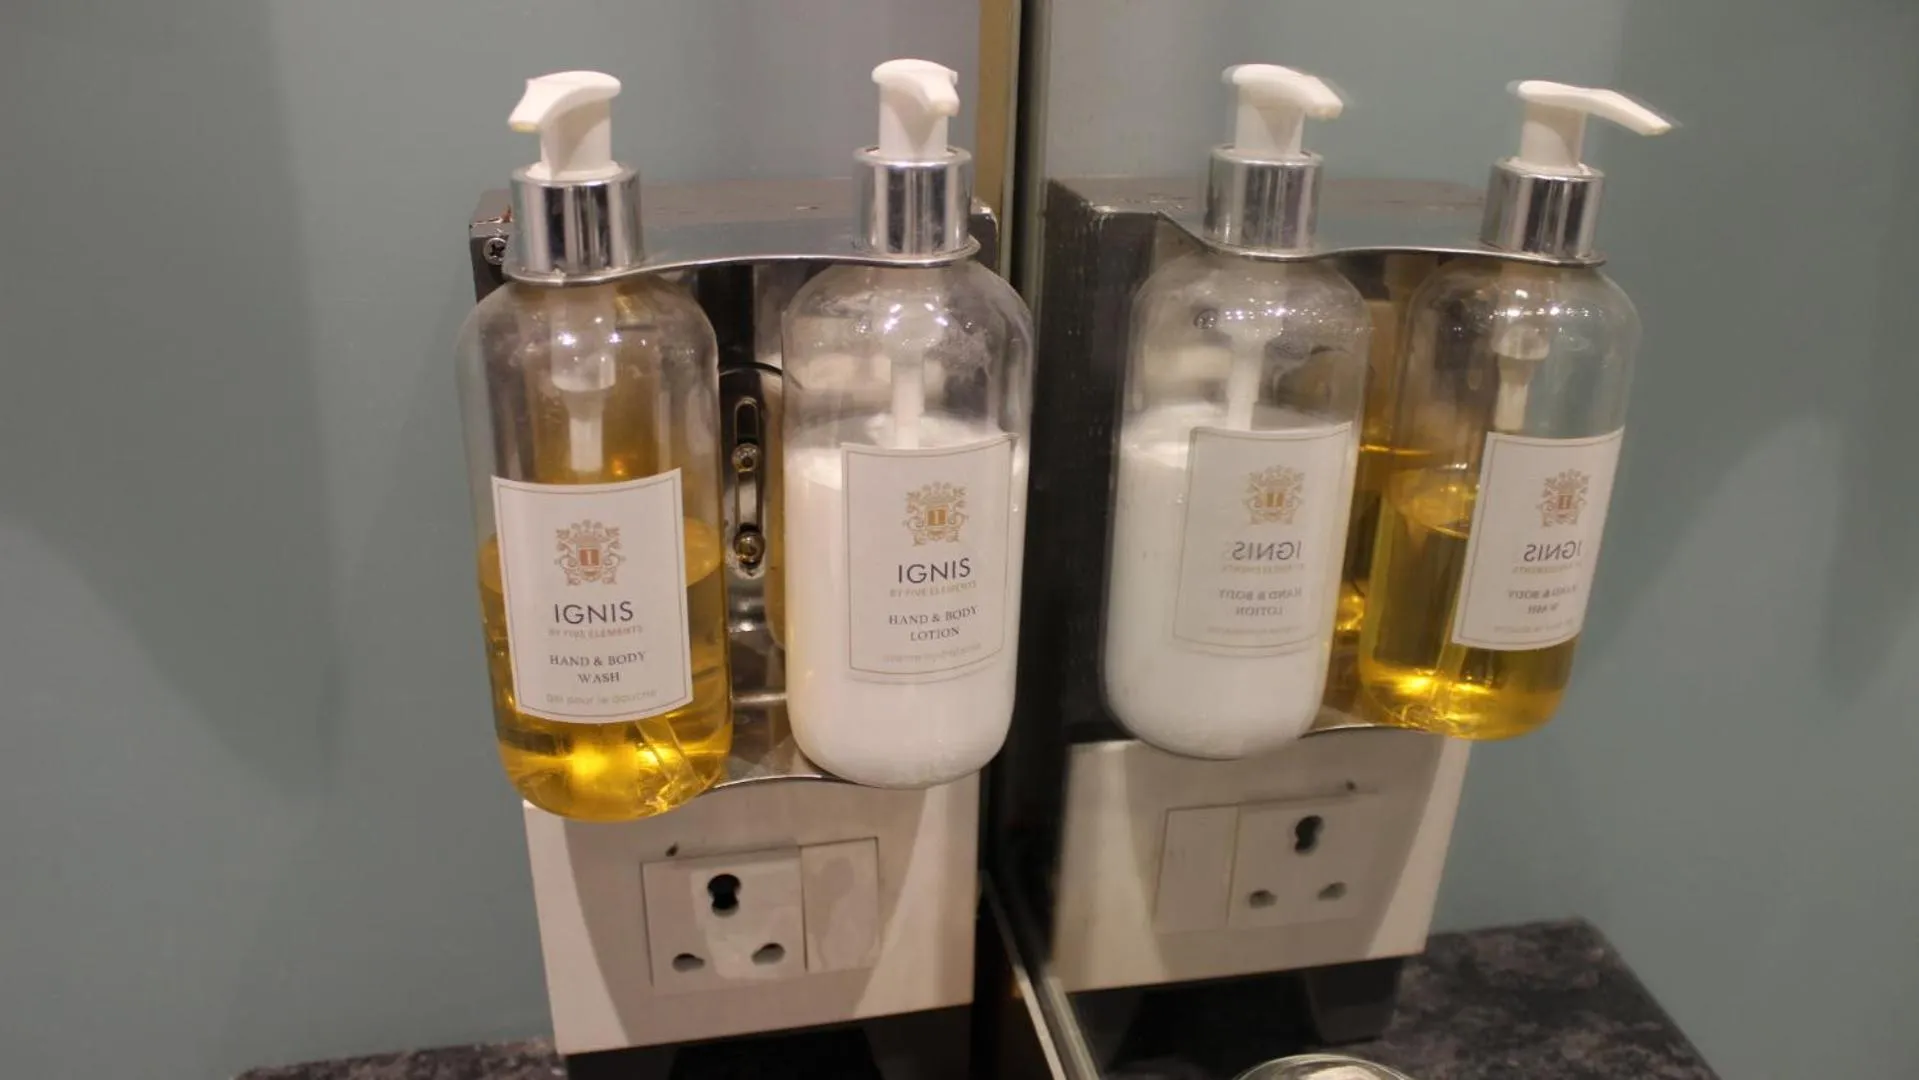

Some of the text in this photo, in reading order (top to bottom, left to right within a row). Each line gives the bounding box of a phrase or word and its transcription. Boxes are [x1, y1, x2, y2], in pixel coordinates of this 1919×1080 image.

[898, 557, 971, 584] IGNIS
[554, 601, 634, 625] IGNIS
[888, 604, 980, 625] HAND & BODY
[909, 626, 960, 642] LOTION
[549, 650, 647, 668] HAND & BODY
[576, 671, 621, 685] WASH
